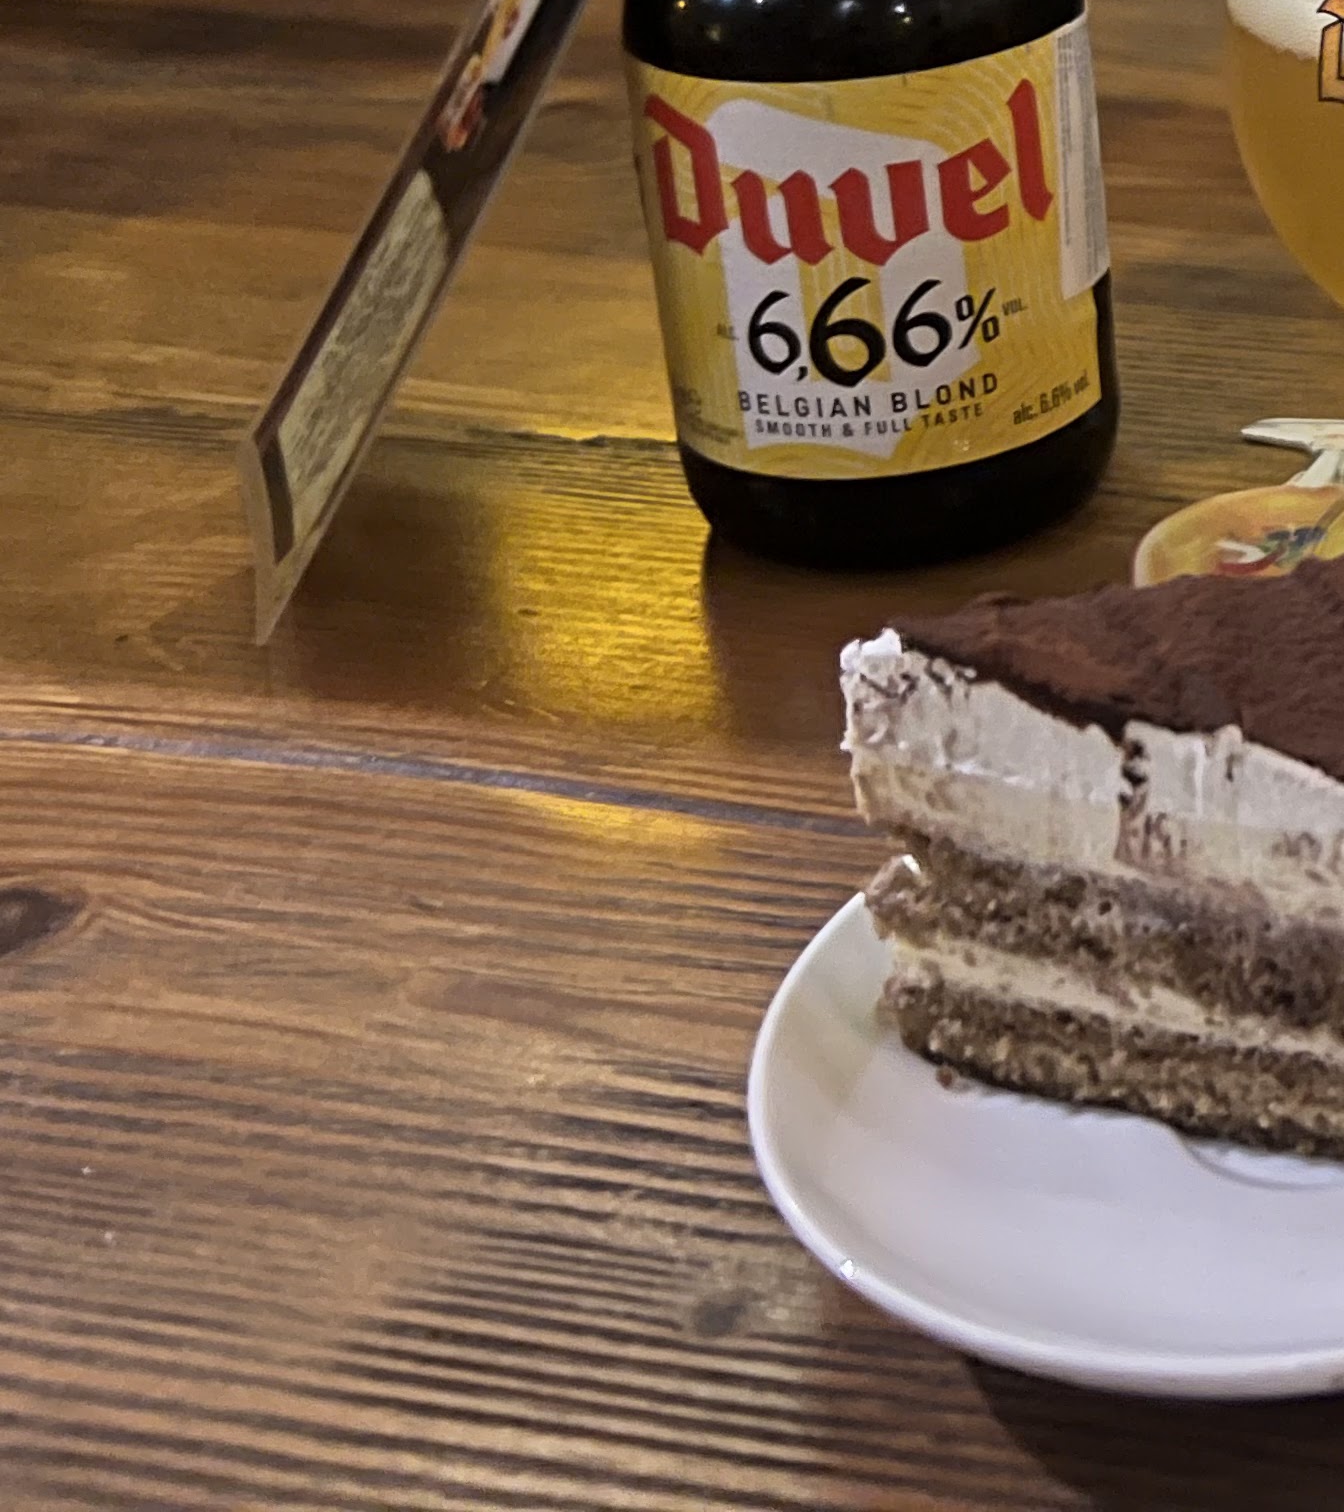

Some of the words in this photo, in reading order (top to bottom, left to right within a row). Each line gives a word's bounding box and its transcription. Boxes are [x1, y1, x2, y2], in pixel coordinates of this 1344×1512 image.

[644, 78, 1053, 266] Duvel
[747, 277, 1000, 387] 6,66%
[737, 390, 872, 420] BELGIAN
[891, 372, 999, 414] BLOND
[755, 418, 832, 438] SMOOTH
[842, 420, 856, 437] &
[864, 417, 914, 437] FULL
[921, 403, 985, 428] TASTE
